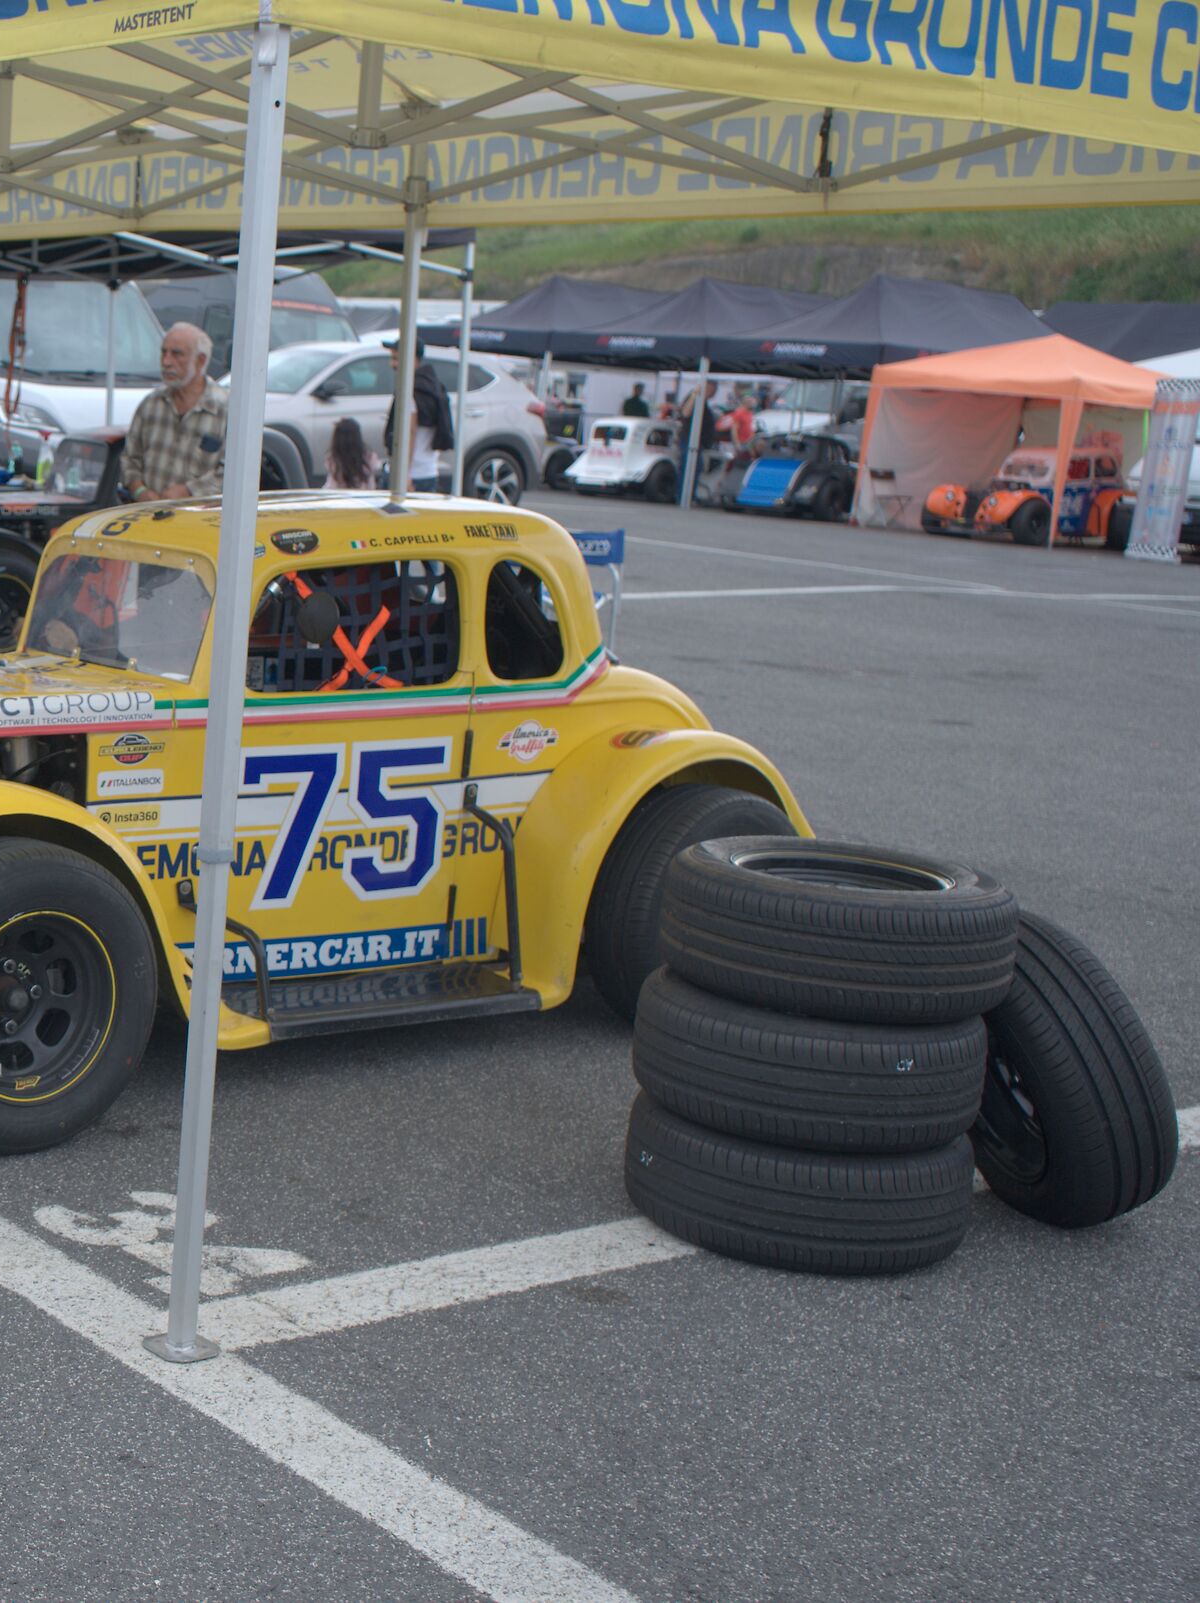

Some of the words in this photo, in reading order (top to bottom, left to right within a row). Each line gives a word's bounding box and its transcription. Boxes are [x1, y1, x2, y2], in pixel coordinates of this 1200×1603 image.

[113, 4, 196, 34] MASTERTENT
[815, 0, 1139, 99] GRONDE
[464, 525, 490, 538] FAKE
[494, 523, 516, 539] TAXI
[369, 538, 382, 547] C.
[385, 534, 439, 546] CAPPELLI
[441, 533, 455, 543] B+
[42, 715, 96, 725] TECHNOLOGY
[103, 712, 152, 722] INNOVATION
[114, 810, 158, 823] Insta360
[242, 740, 448, 904] 75
